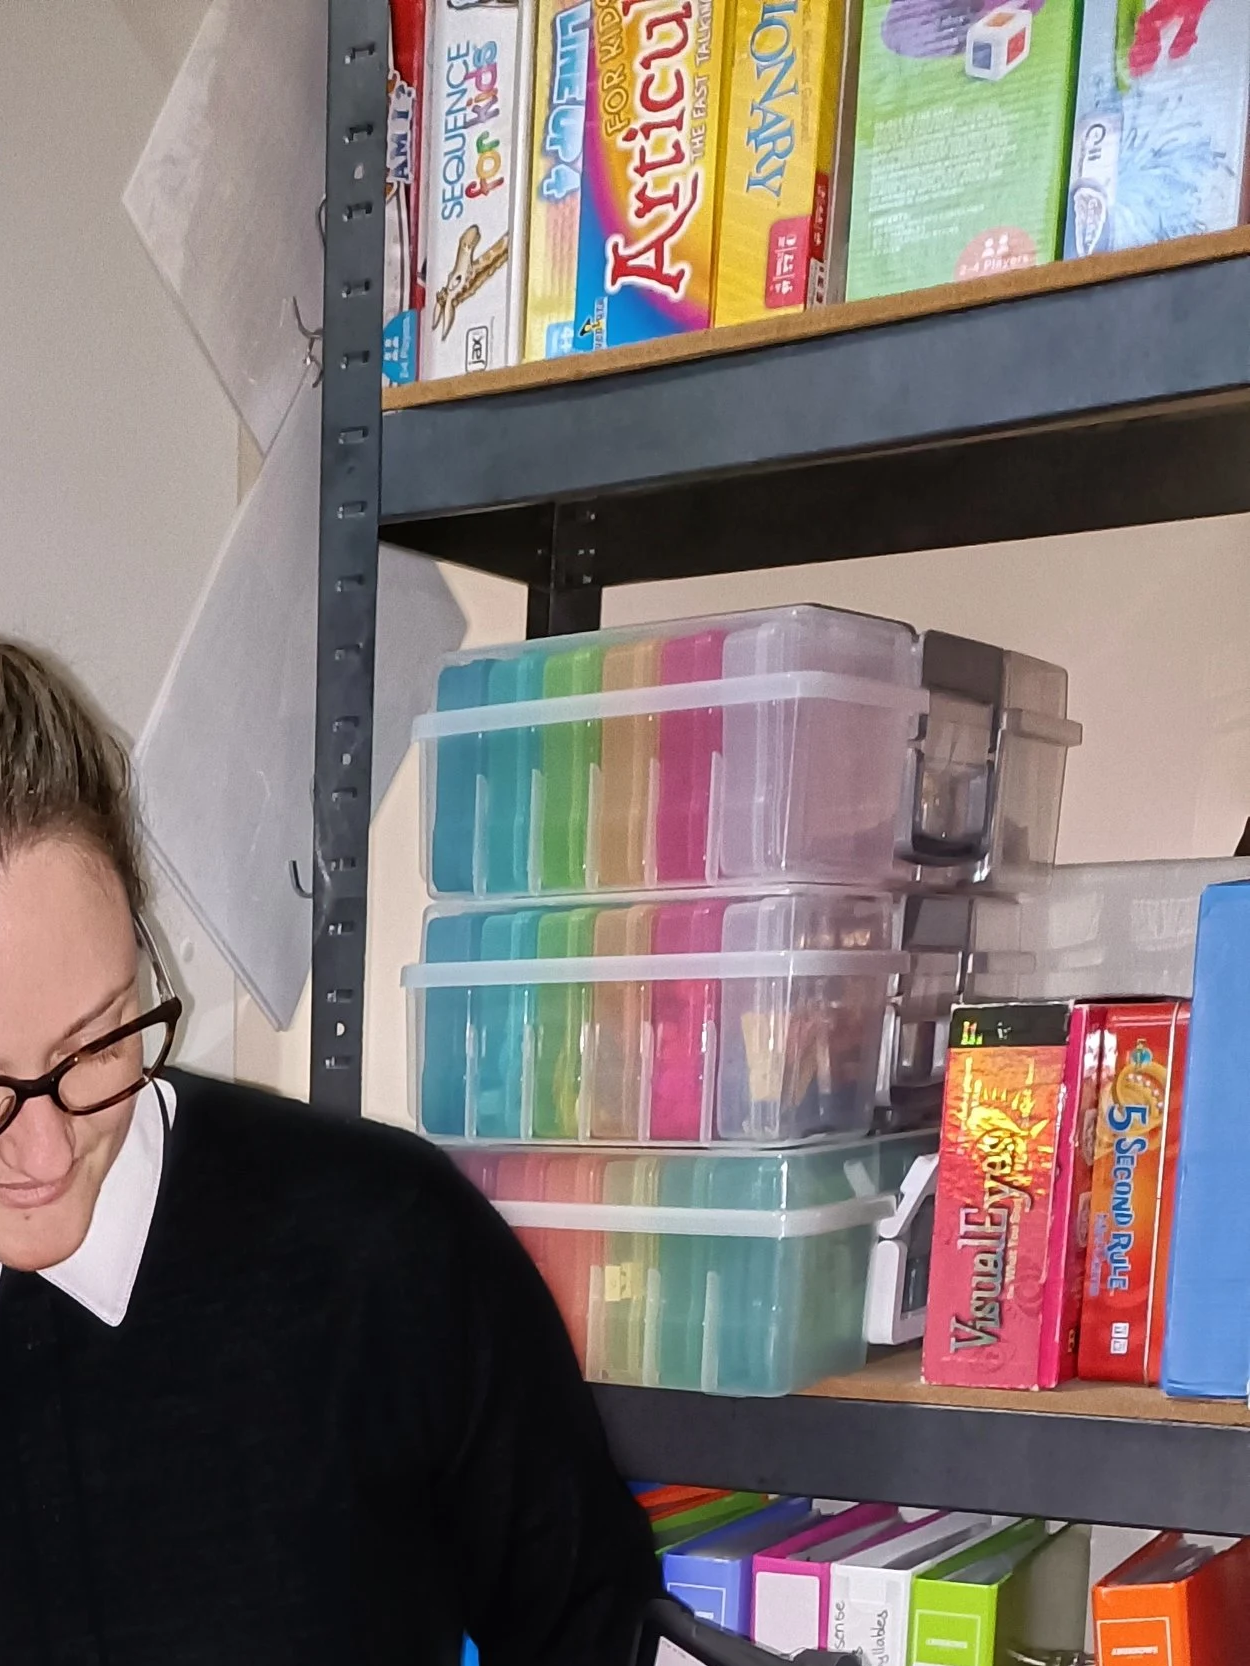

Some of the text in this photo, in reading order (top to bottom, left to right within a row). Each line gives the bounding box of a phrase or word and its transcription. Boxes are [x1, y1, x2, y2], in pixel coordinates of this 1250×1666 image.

[441, 39, 471, 221] SEQUENCE
[463, 39, 504, 199] for kids
[553, 1, 591, 104] LINE
[603, 63, 630, 138] FOR
[690, 0, 713, 164] THE FAST TALKIN
[746, 0, 798, 198] IONARY
[392, 133, 409, 181] AM
[546, 105, 585, 163] UP
[611, 0, 699, 293] Articu
[1108, 1105, 1149, 1291] 5 SECOND RULE
